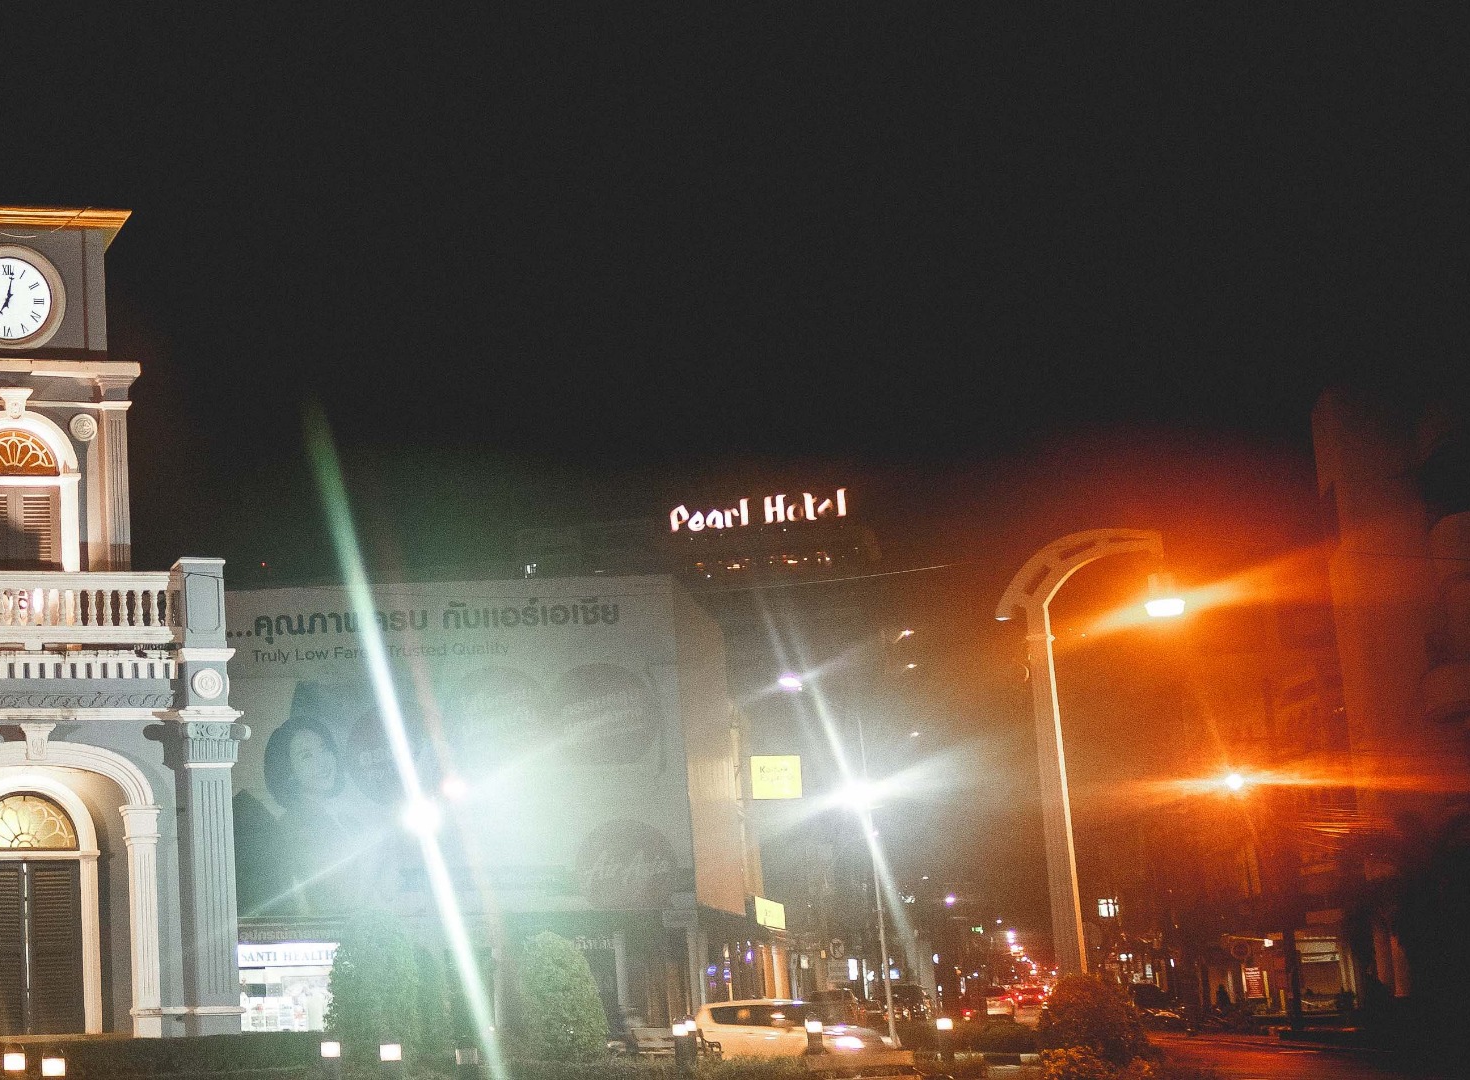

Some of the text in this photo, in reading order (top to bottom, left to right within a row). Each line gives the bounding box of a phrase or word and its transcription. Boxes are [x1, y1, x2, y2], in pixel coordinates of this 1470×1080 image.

[670, 488, 846, 532] Pearl Hotel
[442, 597, 619, 630] กับแอร์เอเชีย
[253, 649, 288, 664] Truly
[296, 648, 328, 661] Low
[241, 950, 334, 962] SANTI HEALTH
